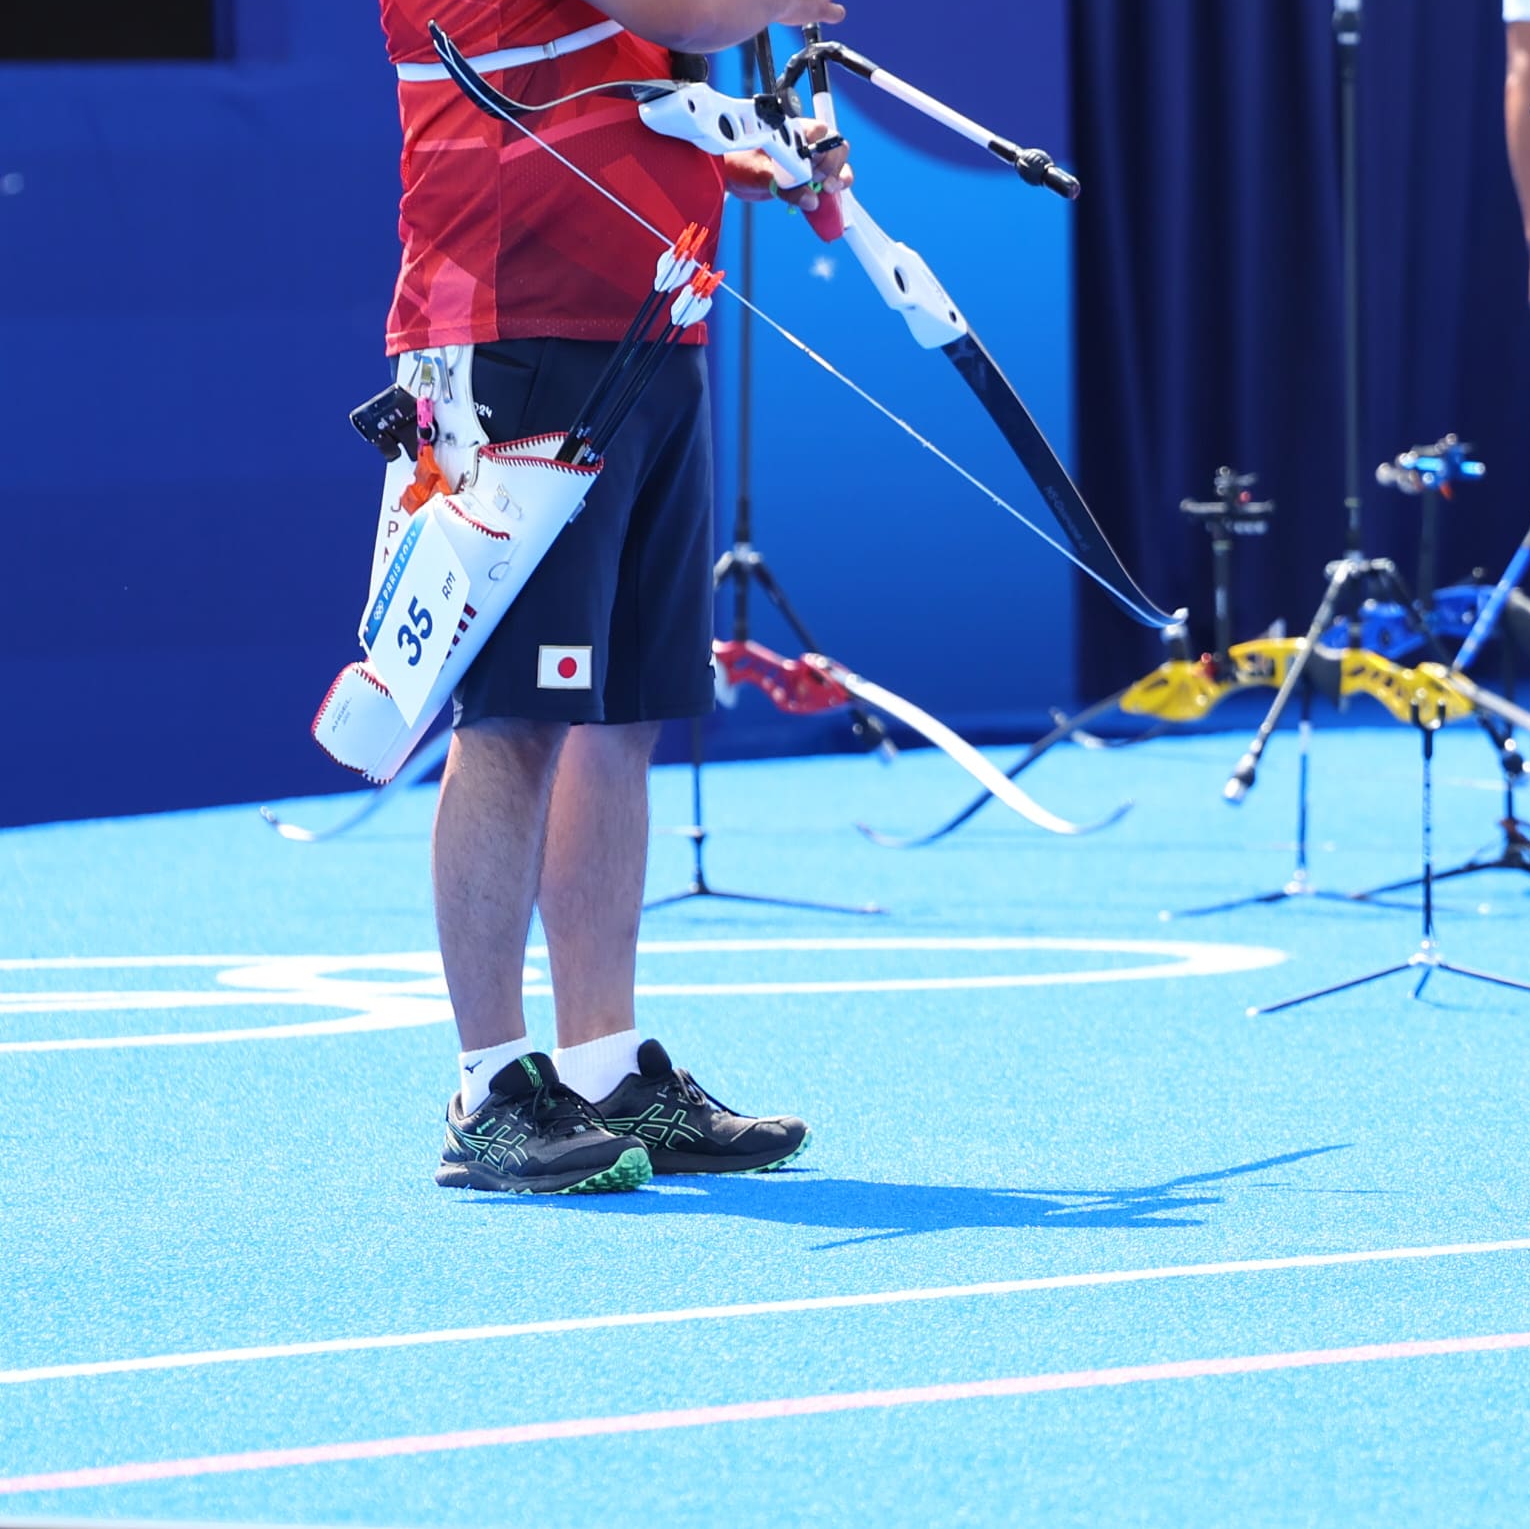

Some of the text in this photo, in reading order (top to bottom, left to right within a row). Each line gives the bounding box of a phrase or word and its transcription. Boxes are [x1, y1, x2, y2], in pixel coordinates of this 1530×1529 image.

[383, 529, 417, 599] PARIS 2024
[441, 569, 457, 600] RM
[397, 595, 433, 667] 35
